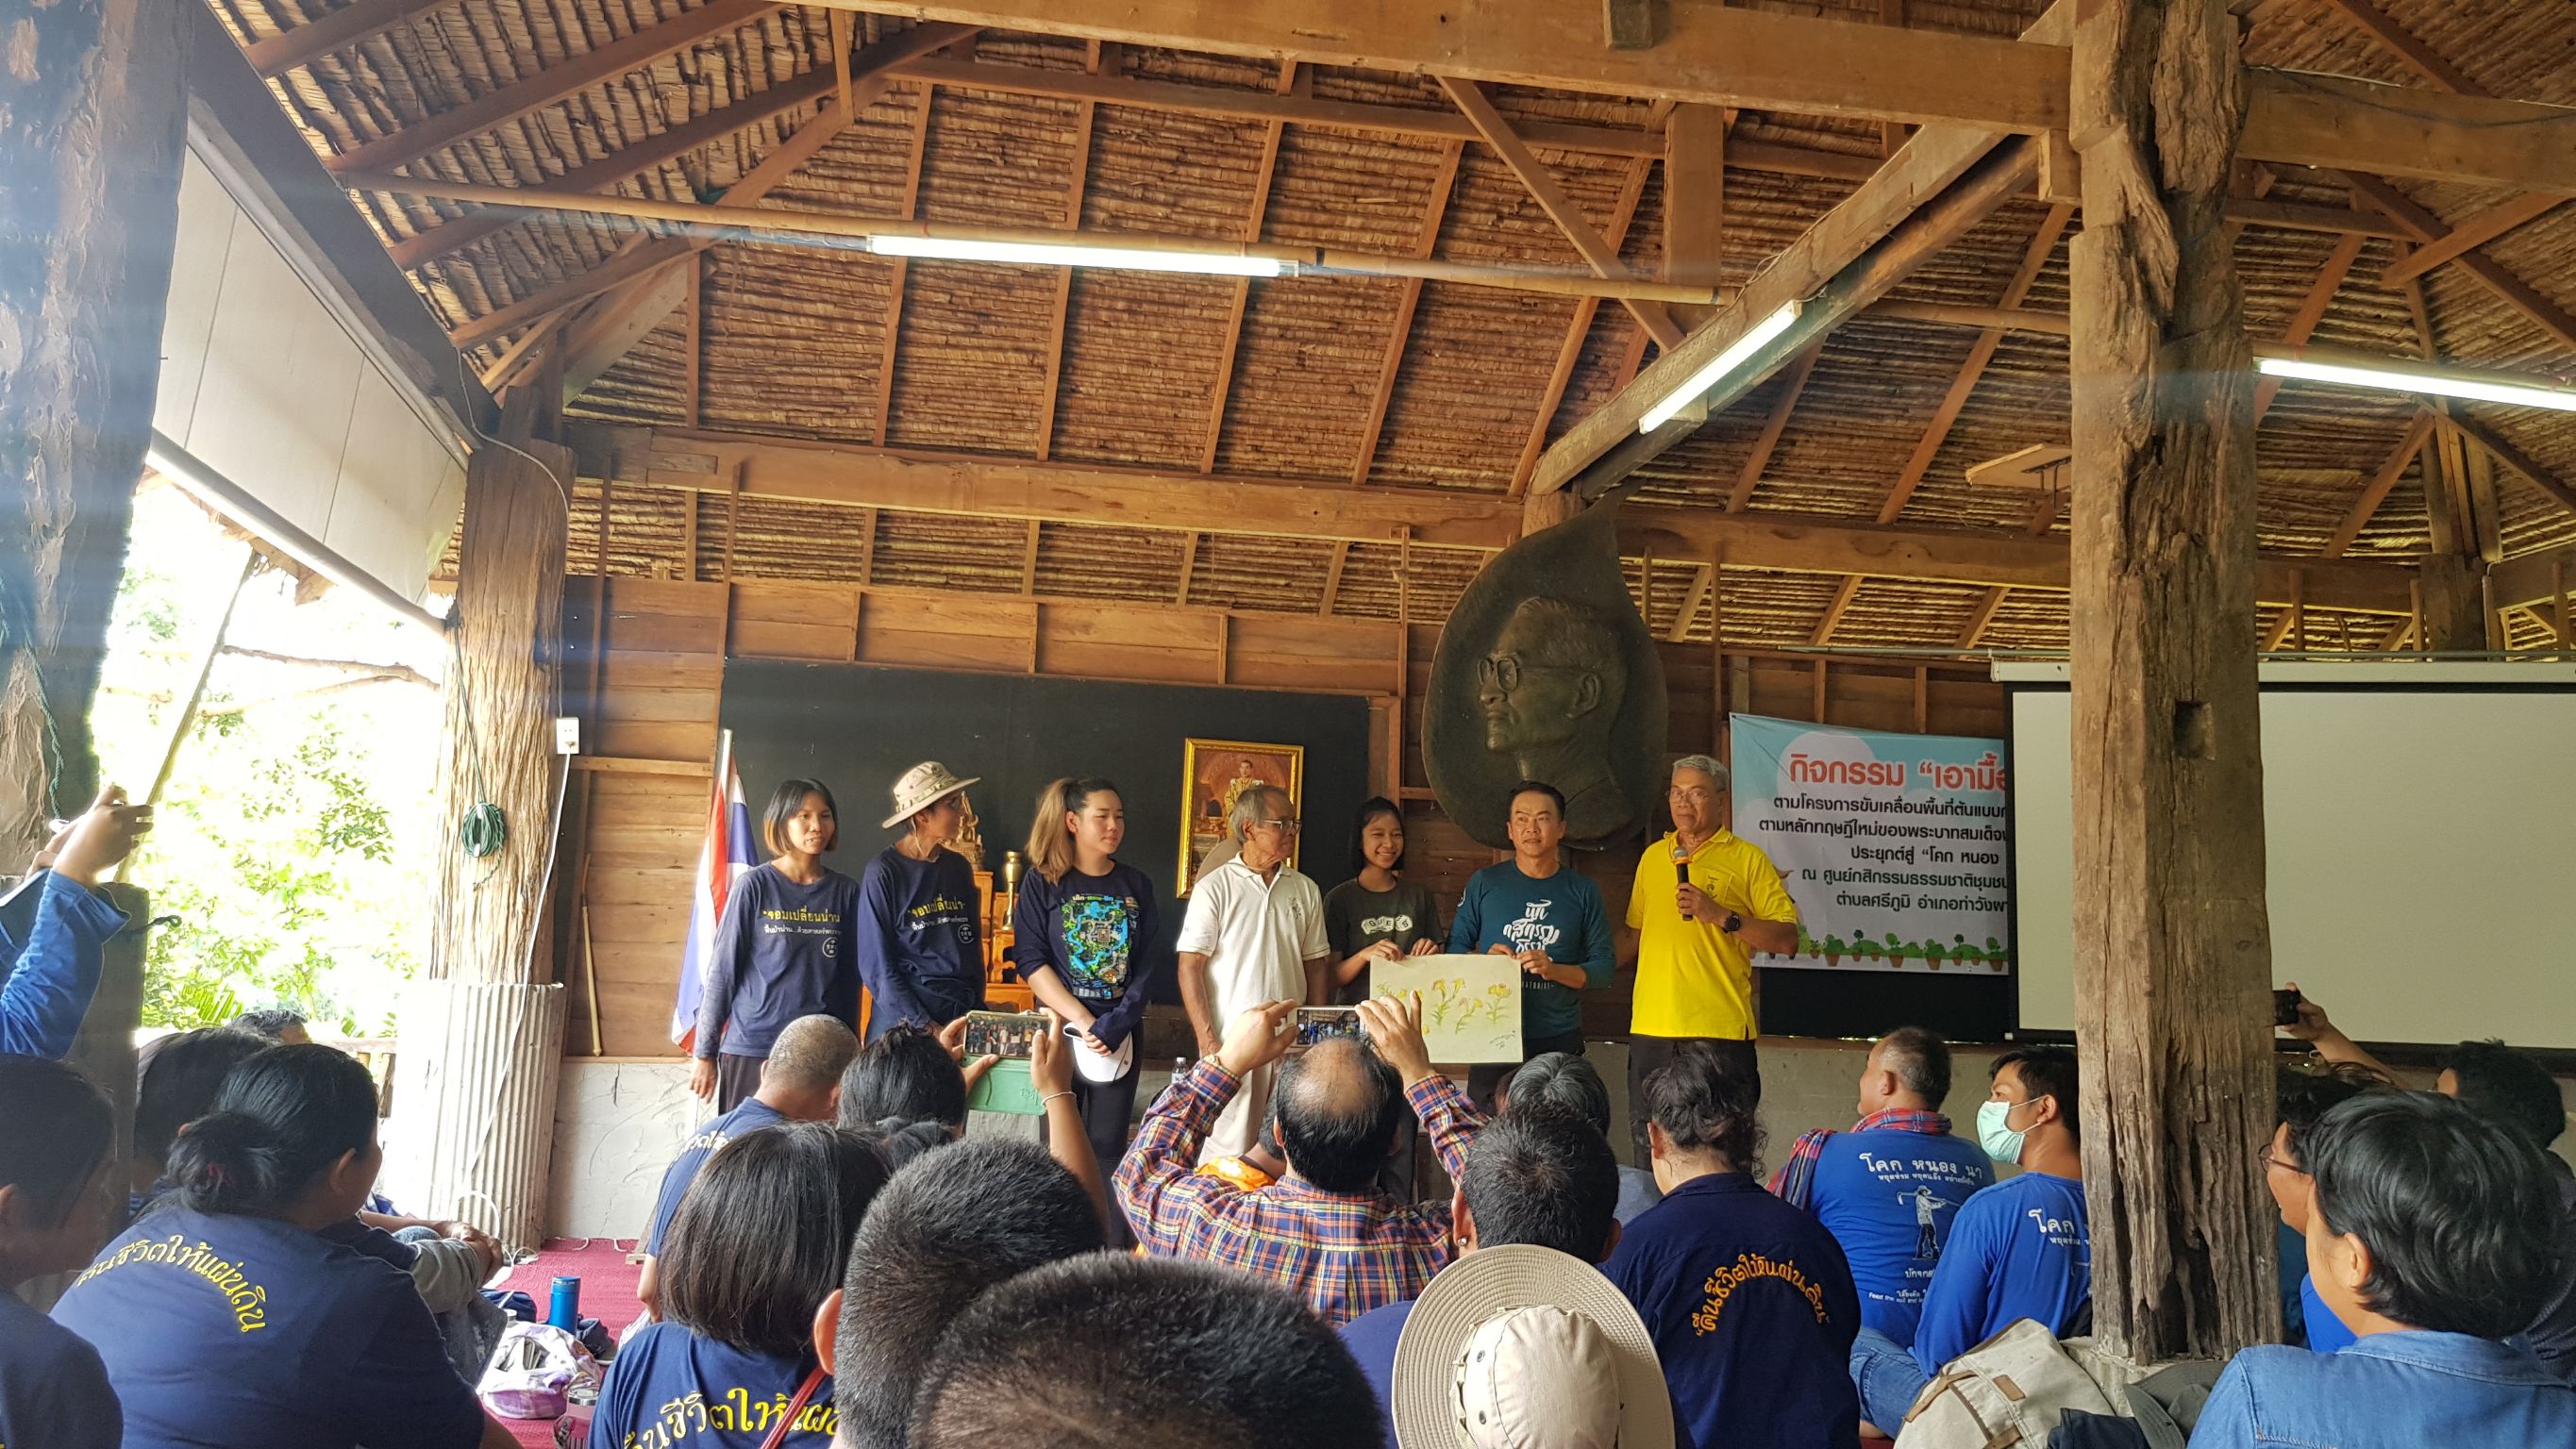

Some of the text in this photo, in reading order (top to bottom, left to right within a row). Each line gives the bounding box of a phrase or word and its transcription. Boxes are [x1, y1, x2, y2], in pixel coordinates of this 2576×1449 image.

[1789, 753, 1904, 787] กิจกรรม
[1759, 817, 2007, 841] ตามหลักทฤษฎีใหม่ของพระบาทสมเด็จ
[1850, 845, 1915, 865] ประยุกต์สู่
[1961, 852, 1999, 864] หนอง
[1802, 869, 1816, 880] ณ
[1836, 891, 1911, 912] ตำบลศรีภูมิ
[1858, 1152, 1982, 1178] โคก หนอง นา
[2028, 1208, 2075, 1234] โคก
[1868, 1291, 1883, 1301] Feed
